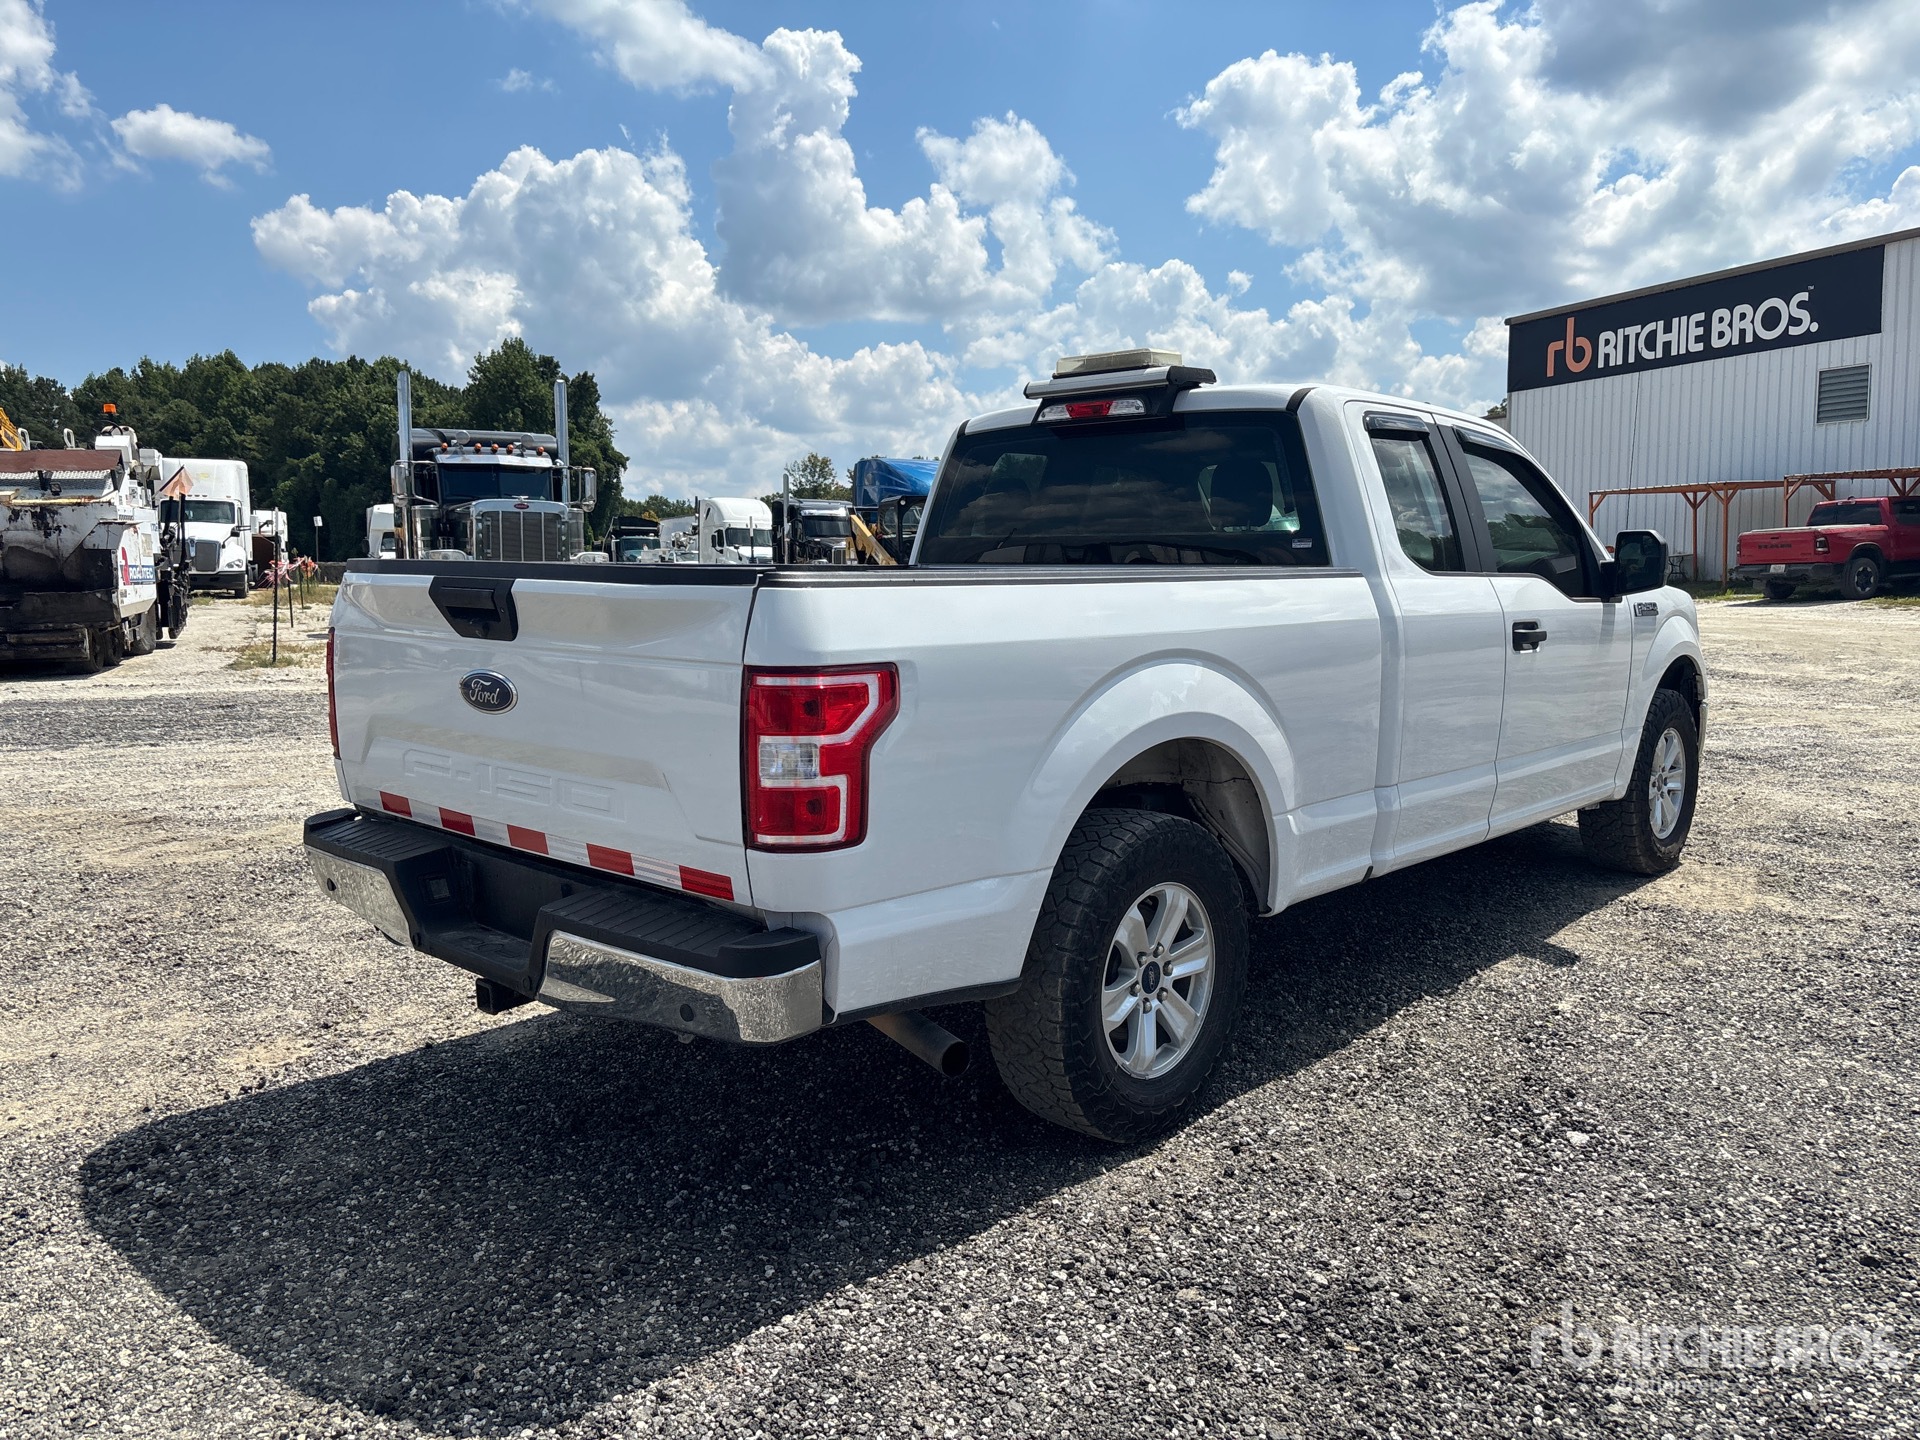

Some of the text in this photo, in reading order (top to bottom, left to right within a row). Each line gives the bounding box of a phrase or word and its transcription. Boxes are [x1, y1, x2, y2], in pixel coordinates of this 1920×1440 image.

[1598, 312, 1705, 368] RITCHIE
[1711, 292, 1818, 348] BROS.
[469, 678, 500, 705] Ford
[402, 748, 628, 823] F-150
